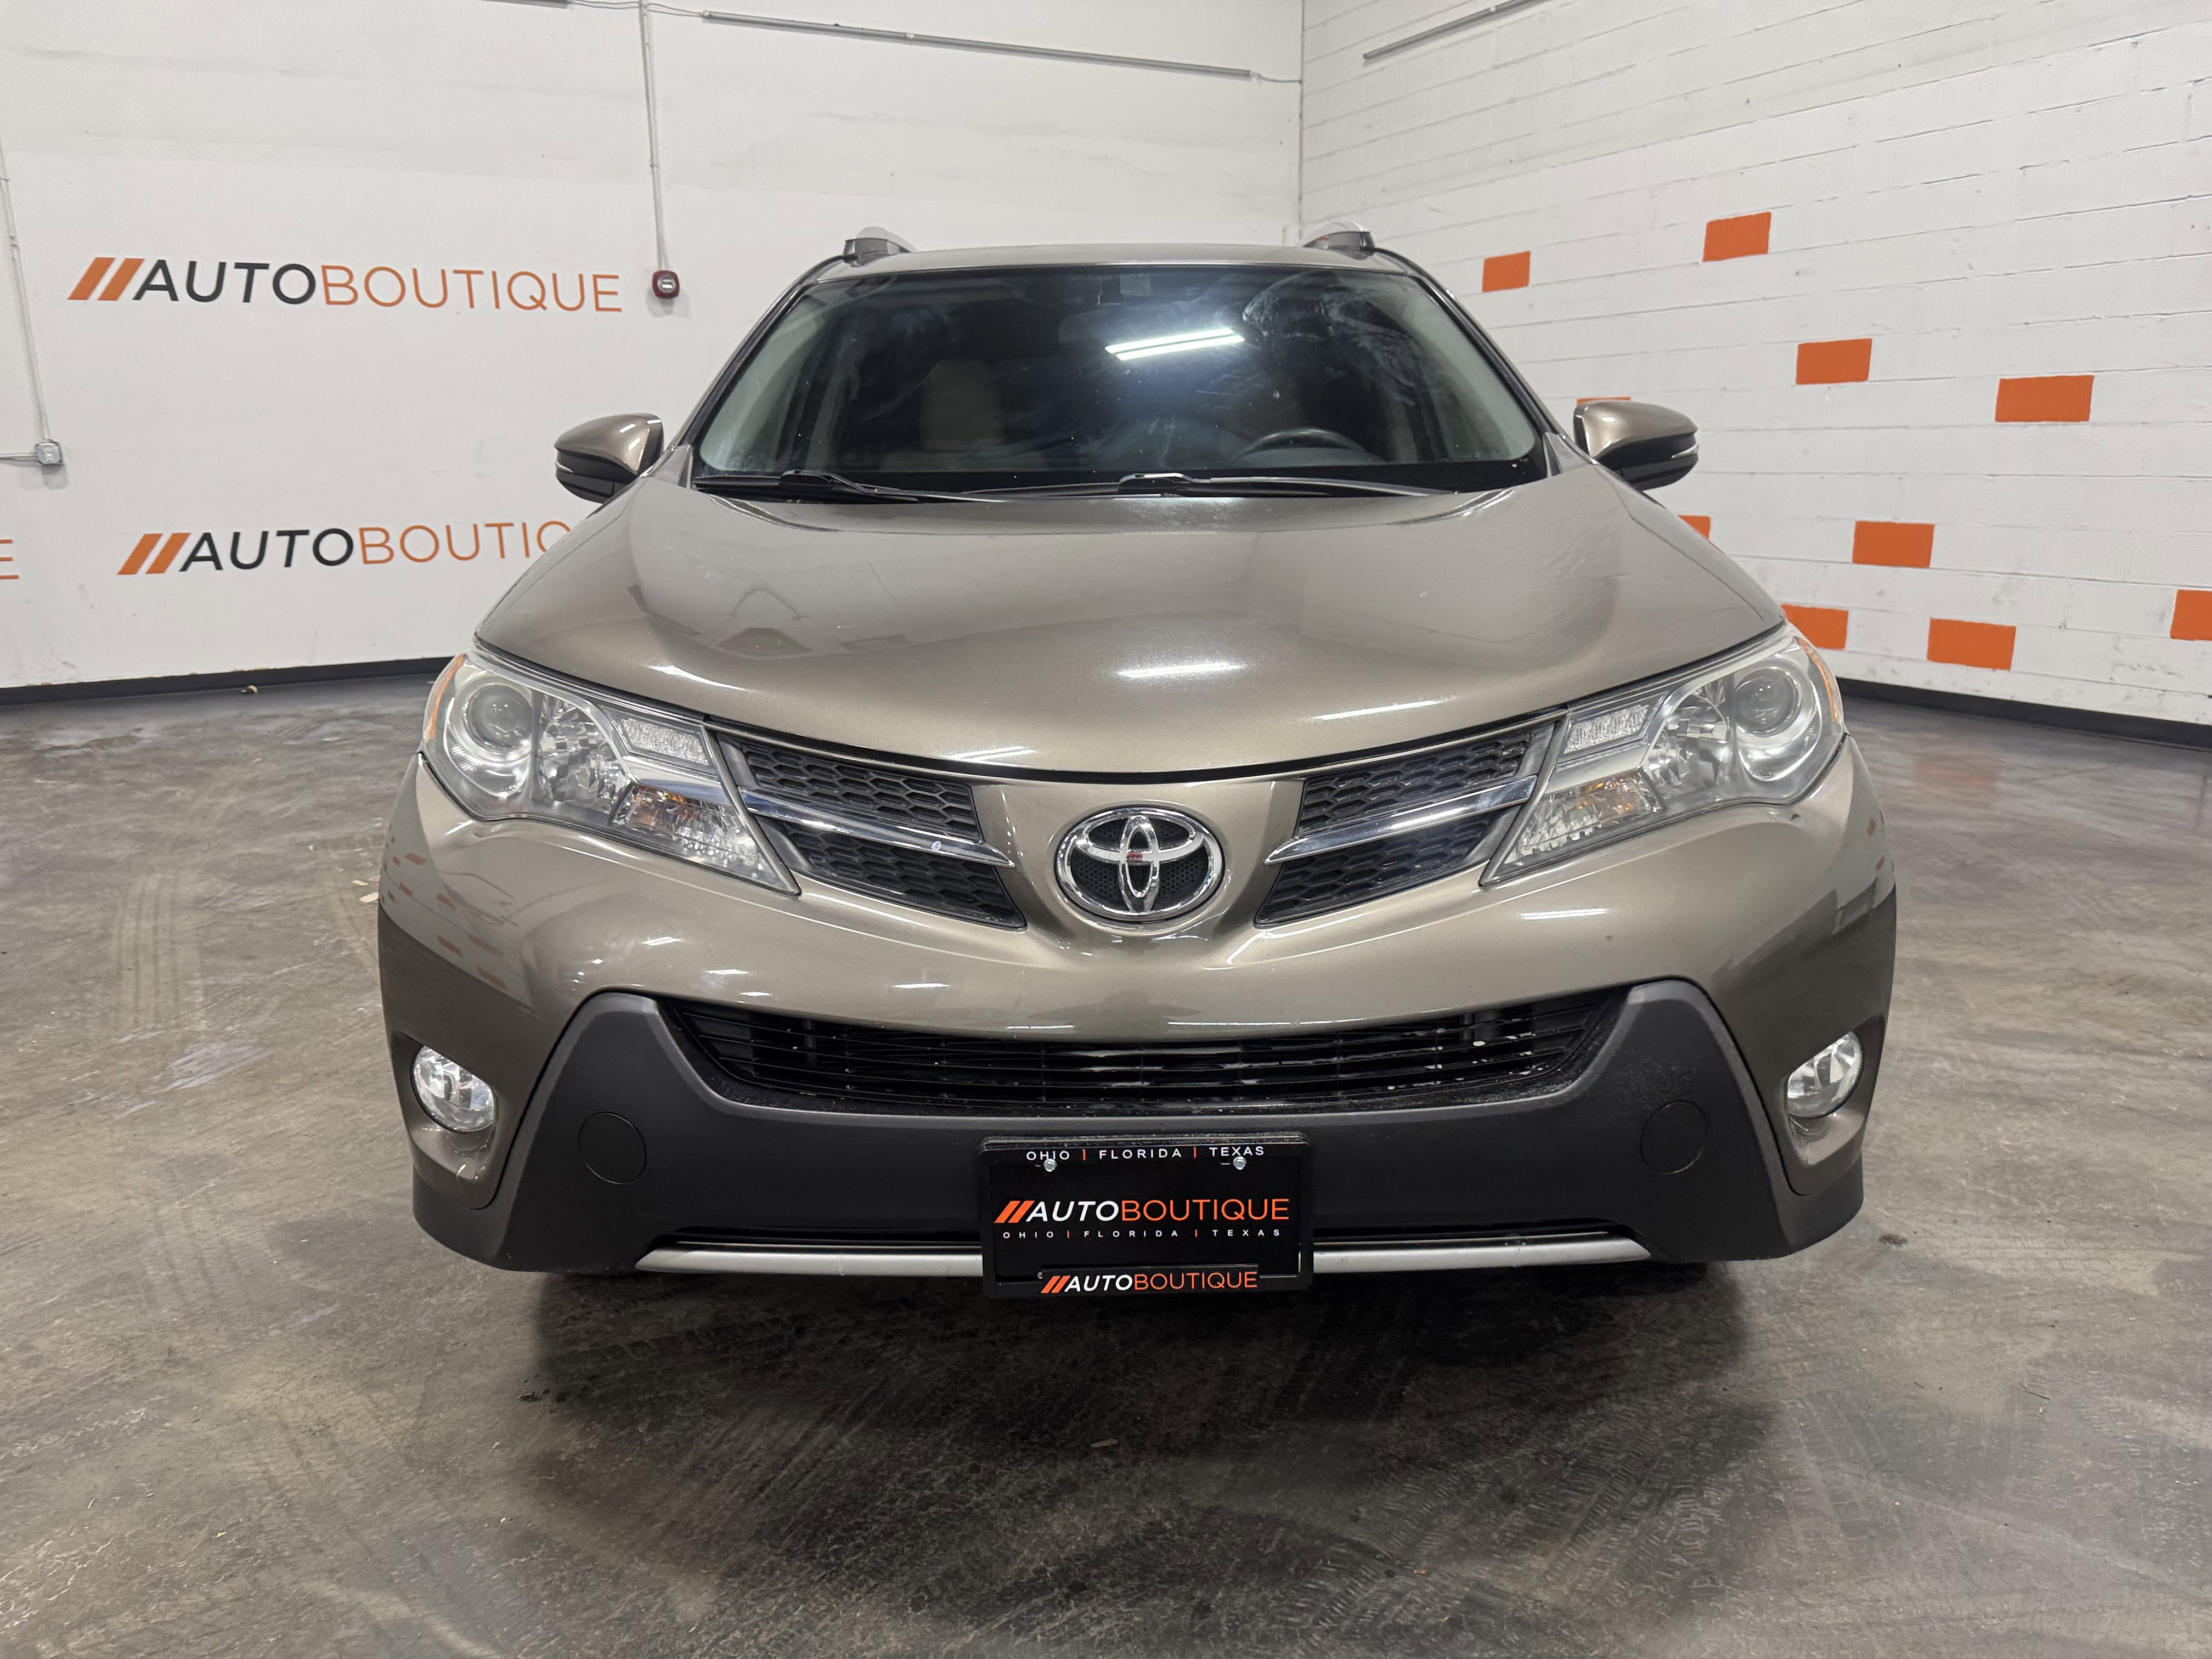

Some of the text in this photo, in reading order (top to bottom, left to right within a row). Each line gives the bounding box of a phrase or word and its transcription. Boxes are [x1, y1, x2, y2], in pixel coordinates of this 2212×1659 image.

[132, 260, 622, 312] AUTOBOUTIQUE
[1026, 1146, 1264, 1161] OHIO FLORIDA TEXAS
[1025, 1198, 1289, 1223] AUTOBOUTIQUE
[1003, 1229, 1280, 1239] OHIO FLORIDA TEXAS
[1064, 1271, 1257, 1293] AUTOBOUTIQUE
